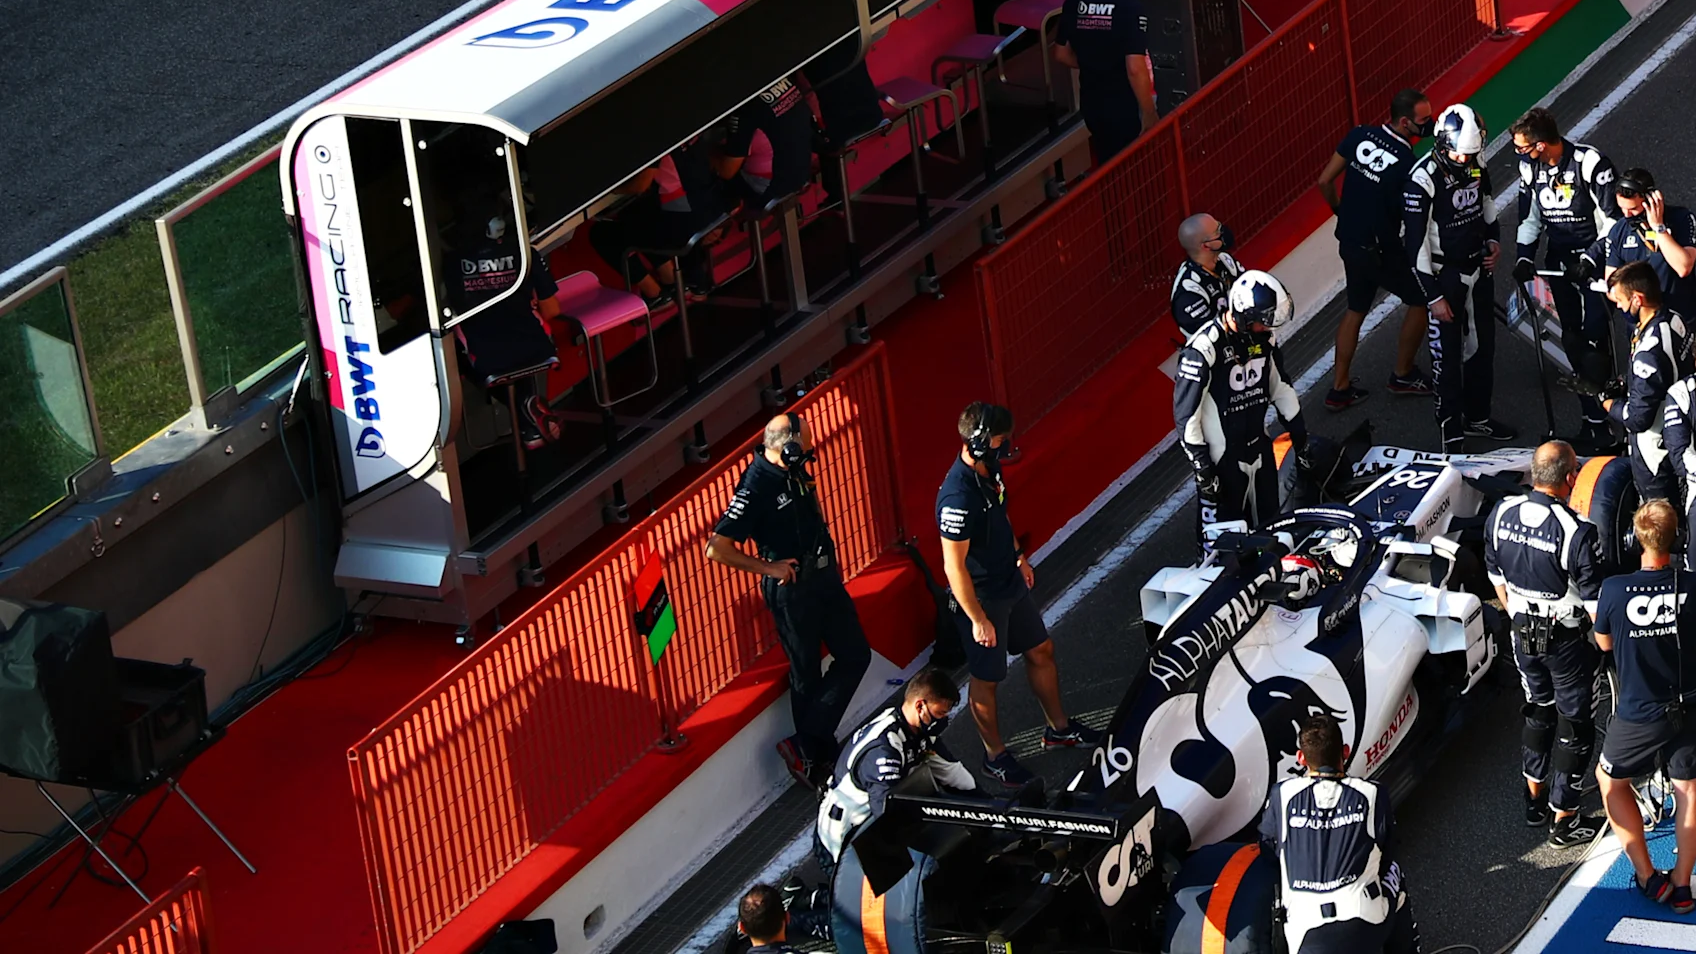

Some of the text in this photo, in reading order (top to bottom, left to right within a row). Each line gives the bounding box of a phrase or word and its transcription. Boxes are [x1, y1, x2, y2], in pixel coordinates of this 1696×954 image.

[1088, 3, 1116, 16] BWT
[769, 77, 794, 99] BWT
[478, 255, 515, 273] BWT
[318, 172, 381, 422] BWT RACING
[1628, 627, 1678, 639] ALPHATAUR
[1363, 695, 1414, 766] HONDA
[1091, 733, 1134, 789] 26
[1290, 803, 1364, 818] SCUDERIA
[1304, 811, 1365, 831] ALPHATAURI
